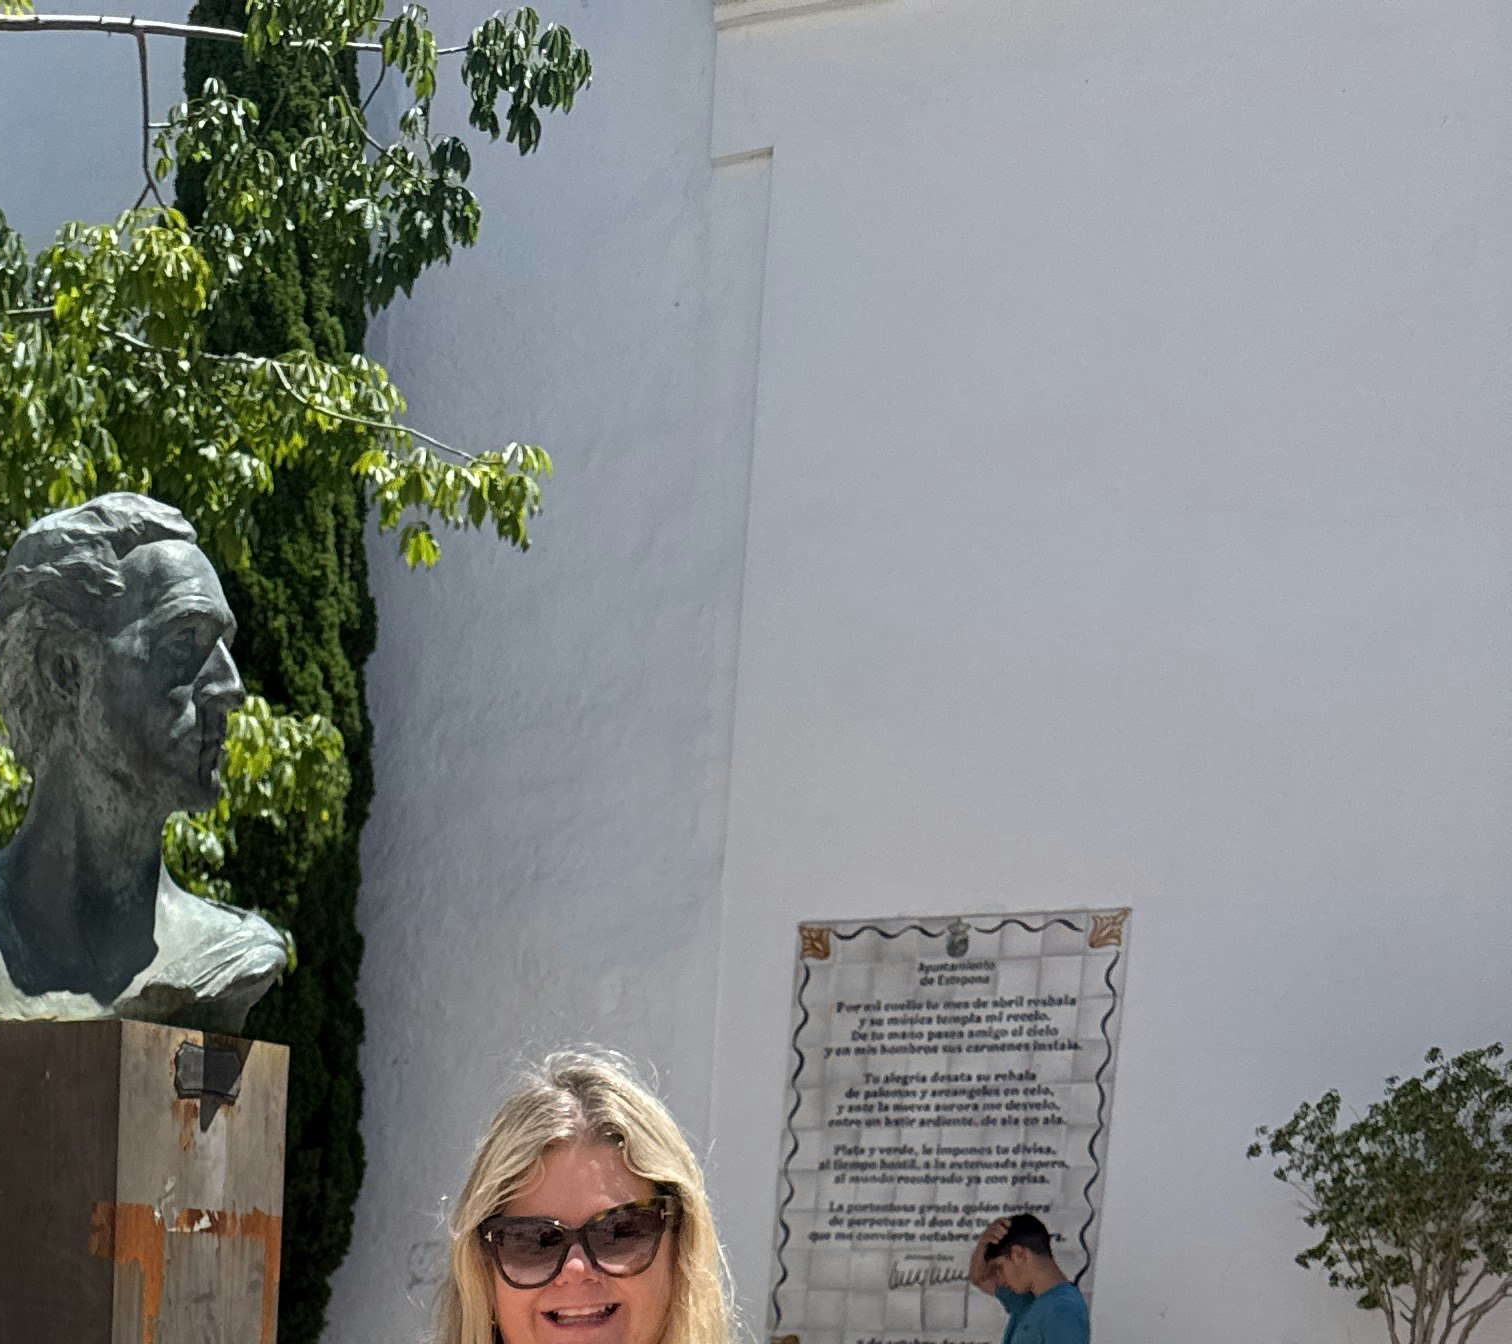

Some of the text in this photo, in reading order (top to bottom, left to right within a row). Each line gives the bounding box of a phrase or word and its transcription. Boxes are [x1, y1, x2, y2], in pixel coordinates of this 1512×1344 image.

[937, 974, 990, 987] Estepona
[991, 995, 1024, 1007] abril
[967, 1025, 1008, 1040] amigo
[1026, 1023, 1059, 1037] cielo
